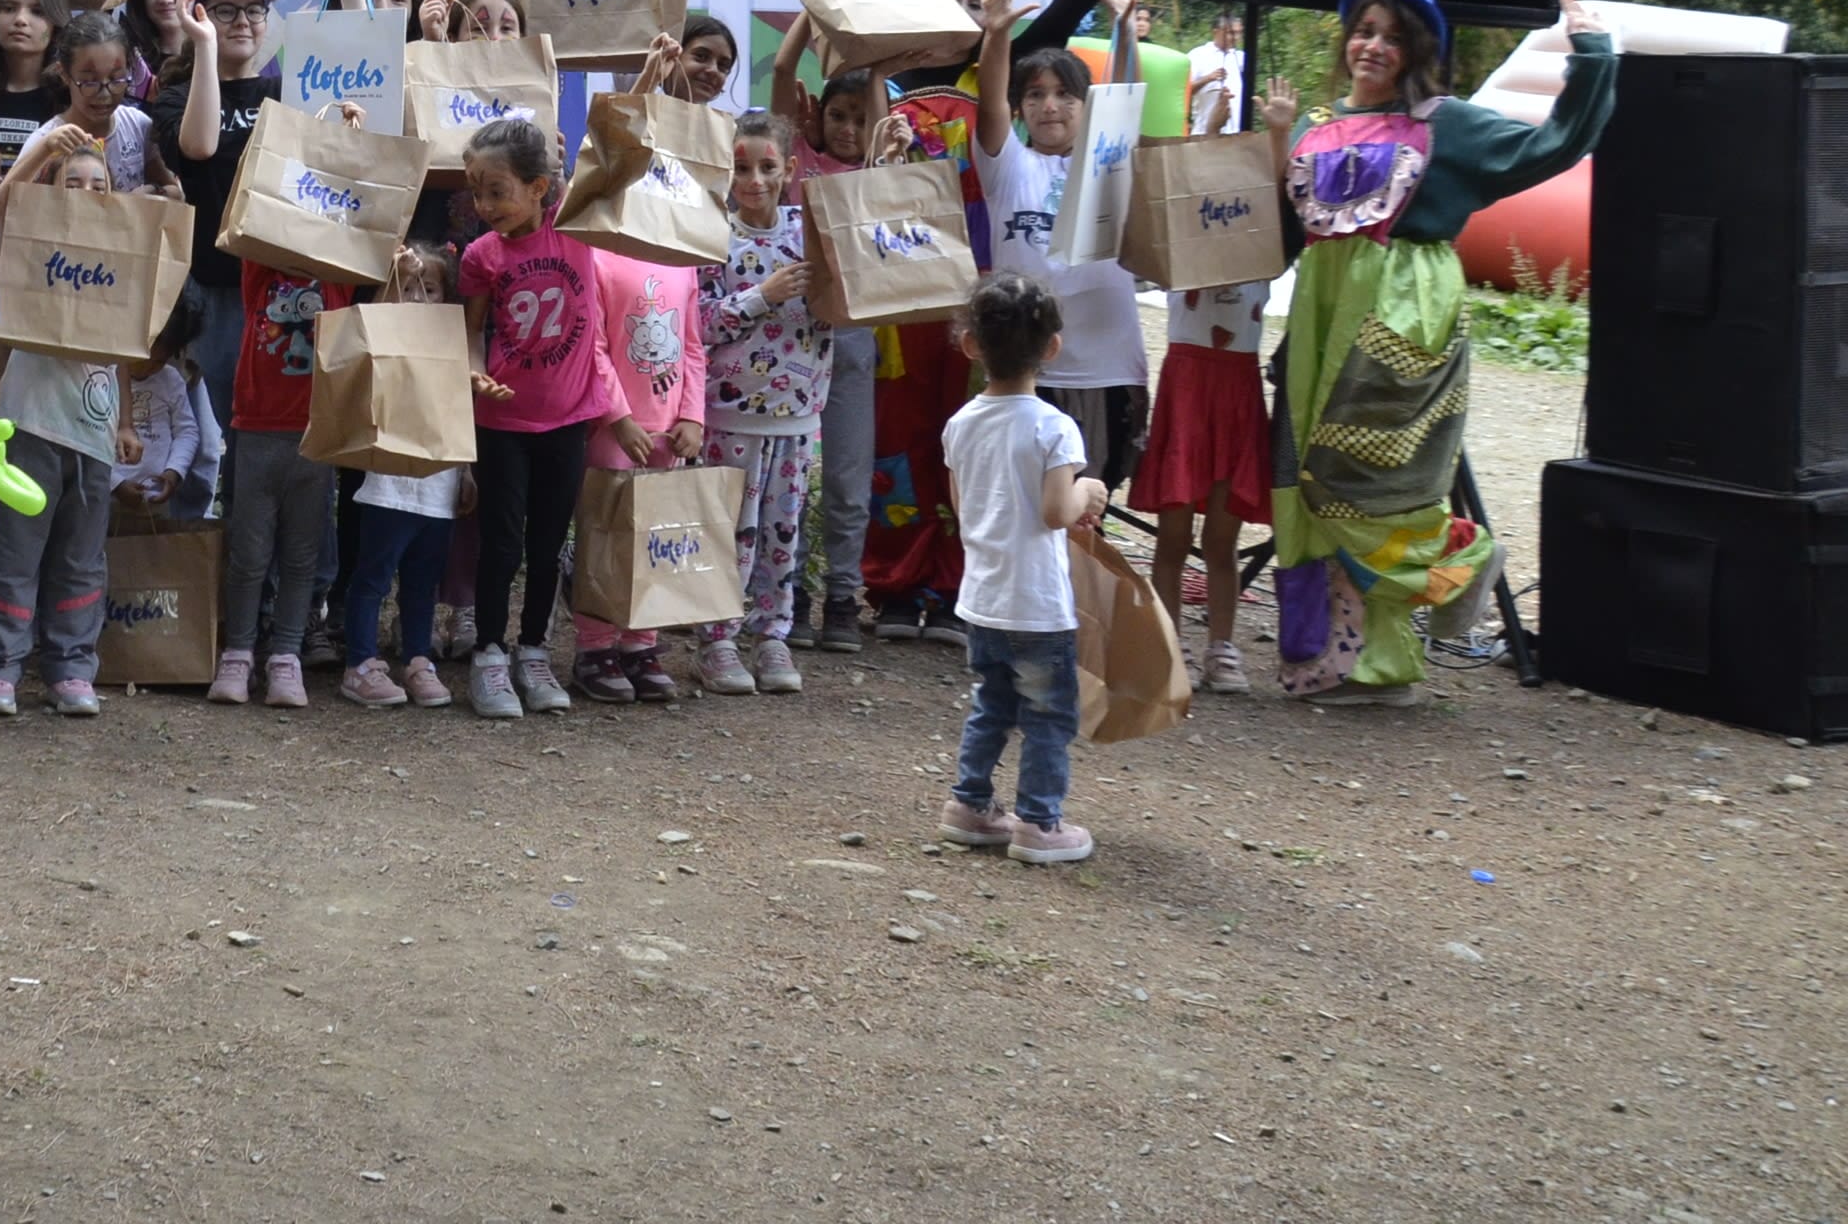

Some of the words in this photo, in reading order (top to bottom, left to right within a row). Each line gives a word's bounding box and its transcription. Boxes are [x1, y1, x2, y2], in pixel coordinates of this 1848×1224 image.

[297, 55, 384, 101] floteks
[296, 171, 361, 211] floteks
[44, 251, 115, 290] floteks
[508, 287, 564, 339] 92
